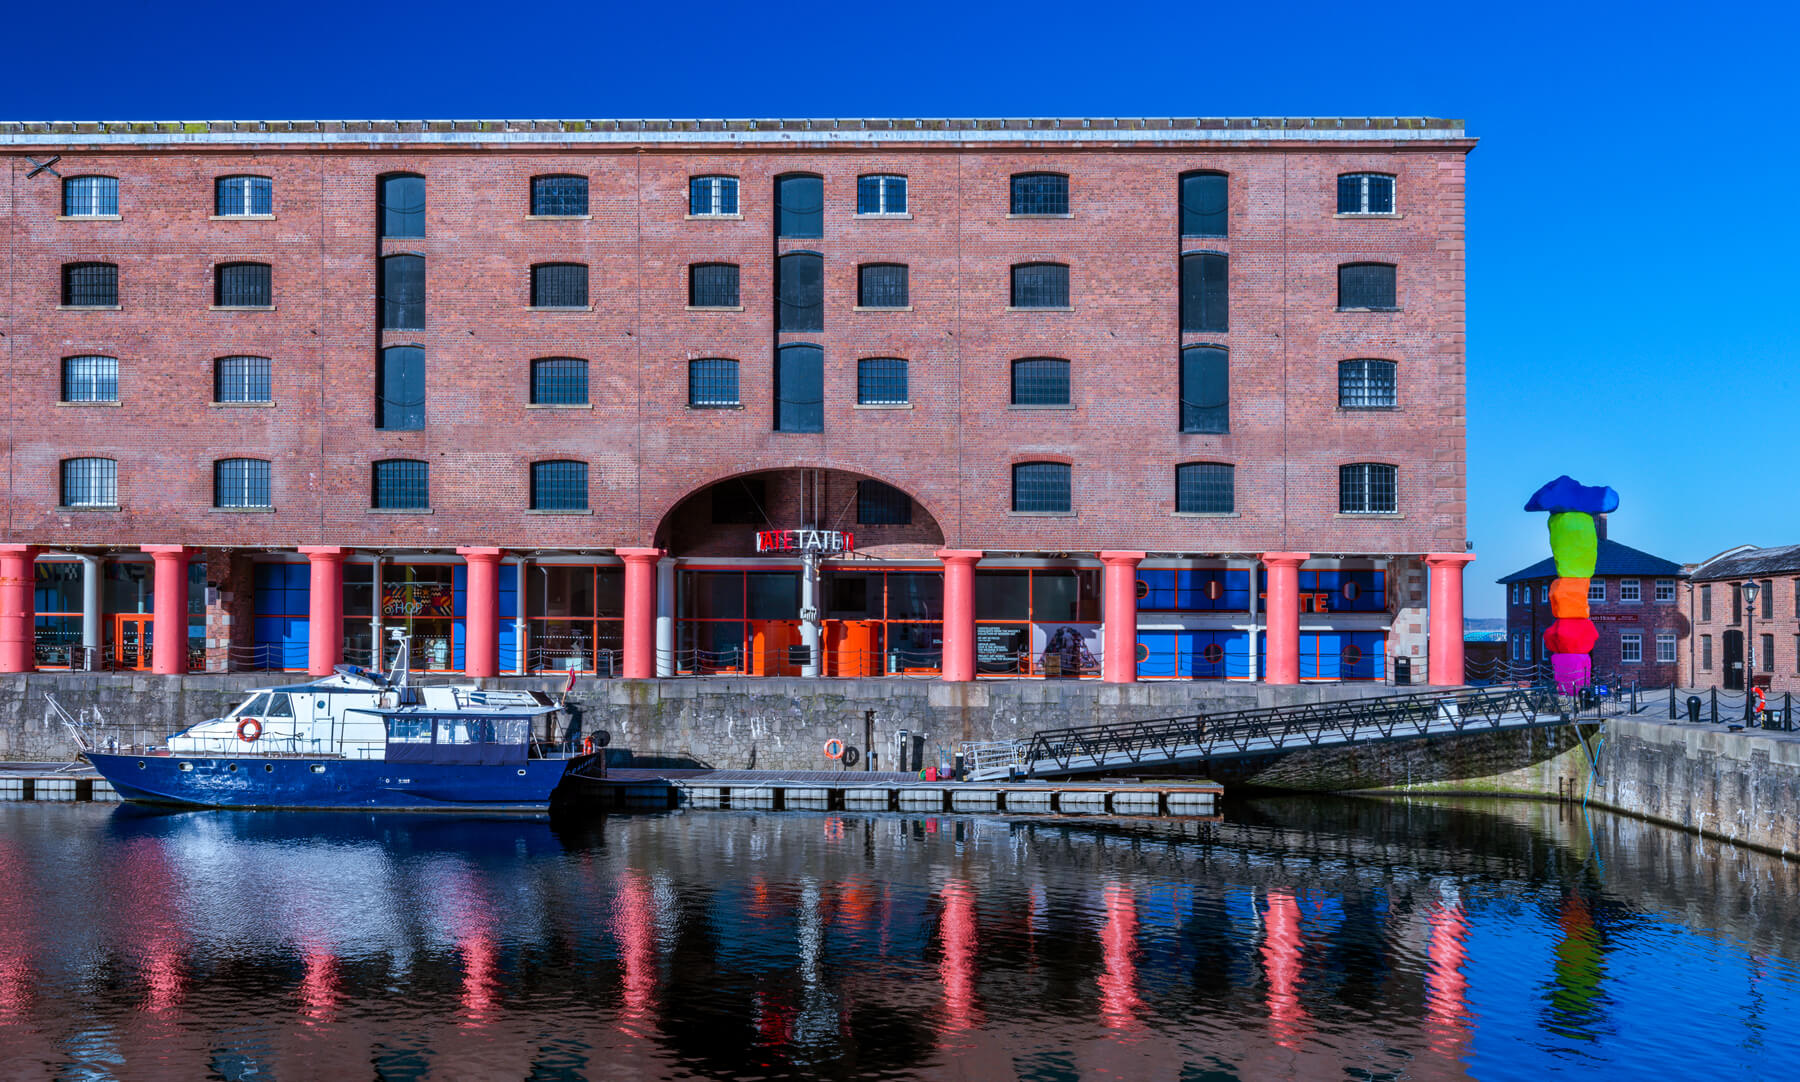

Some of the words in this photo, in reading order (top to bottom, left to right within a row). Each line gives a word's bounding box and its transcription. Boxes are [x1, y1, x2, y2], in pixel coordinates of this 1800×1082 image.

[759, 529, 793, 551] TATE
[795, 529, 841, 550] TATE
[1259, 593, 1328, 613] TE
